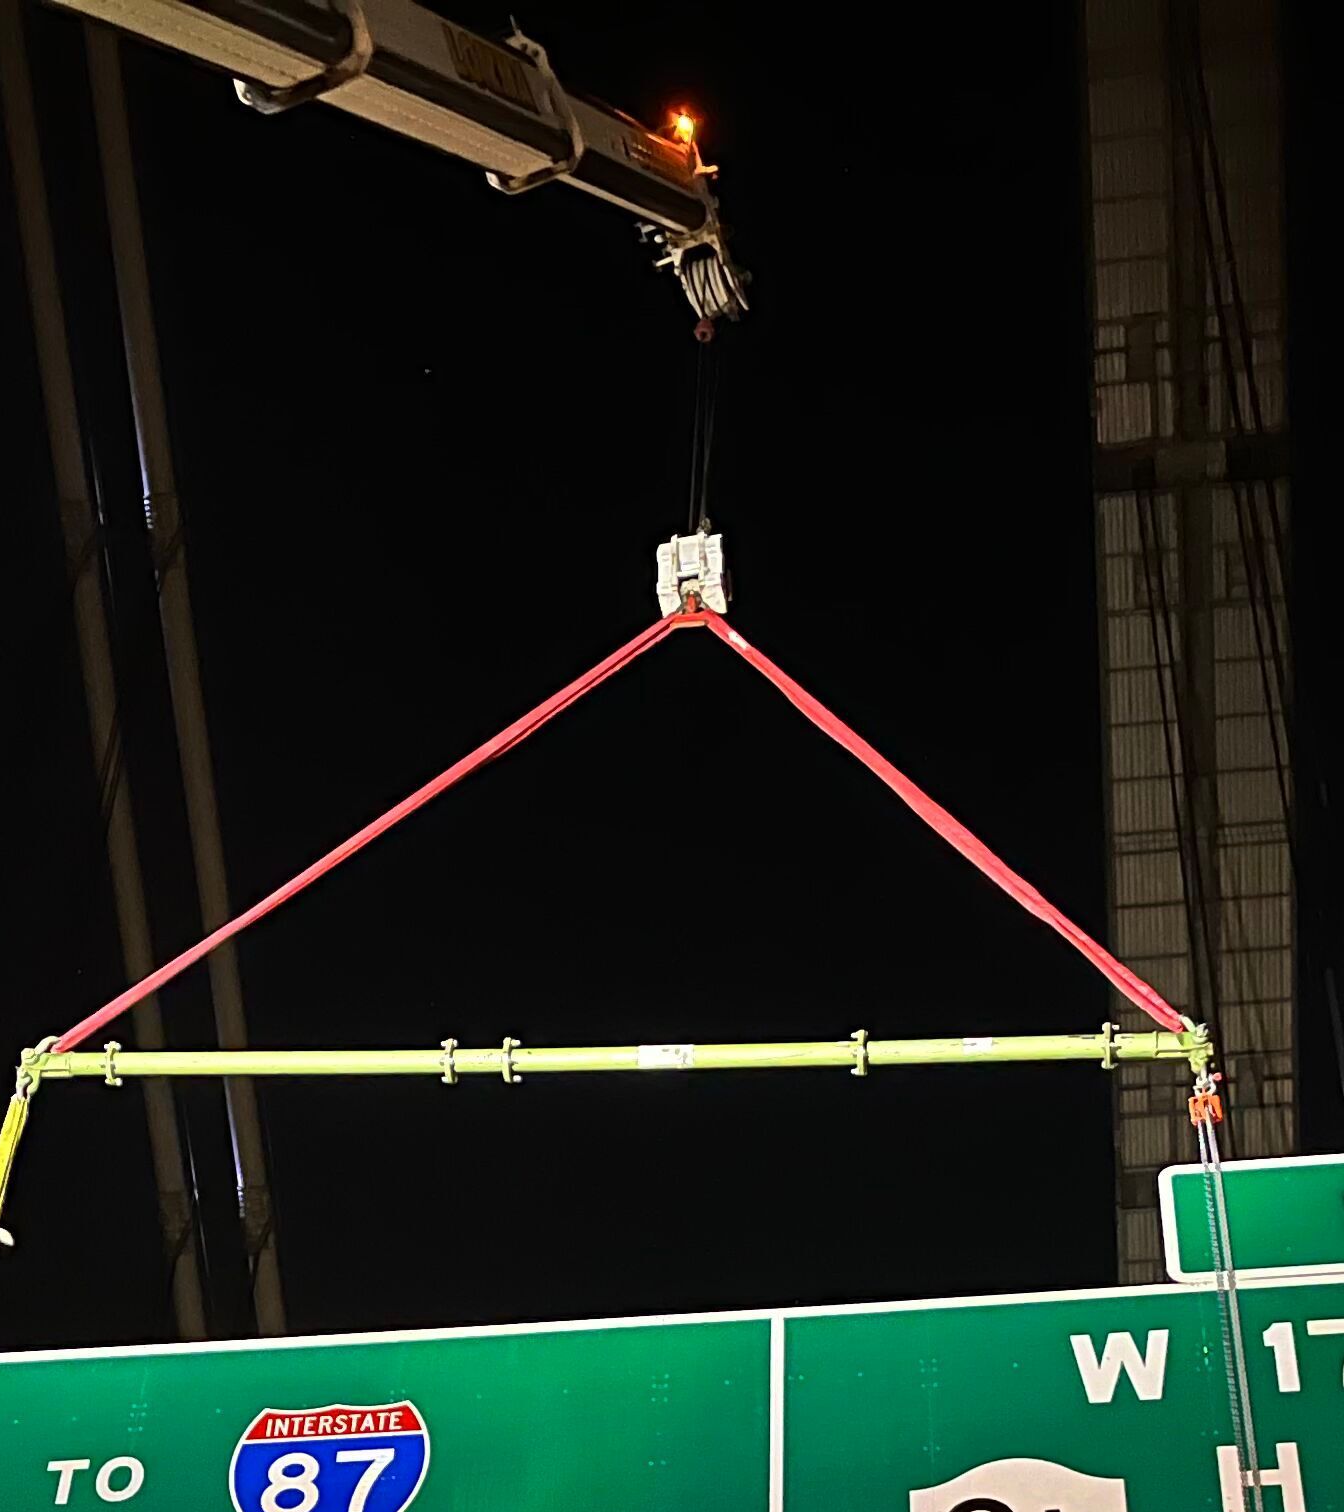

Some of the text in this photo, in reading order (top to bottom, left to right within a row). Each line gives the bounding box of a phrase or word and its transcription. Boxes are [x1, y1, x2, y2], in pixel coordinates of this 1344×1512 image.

[1068, 1328, 1170, 1405] W
[264, 1410, 404, 1438] INTERSTATE
[46, 1455, 146, 1506] TO
